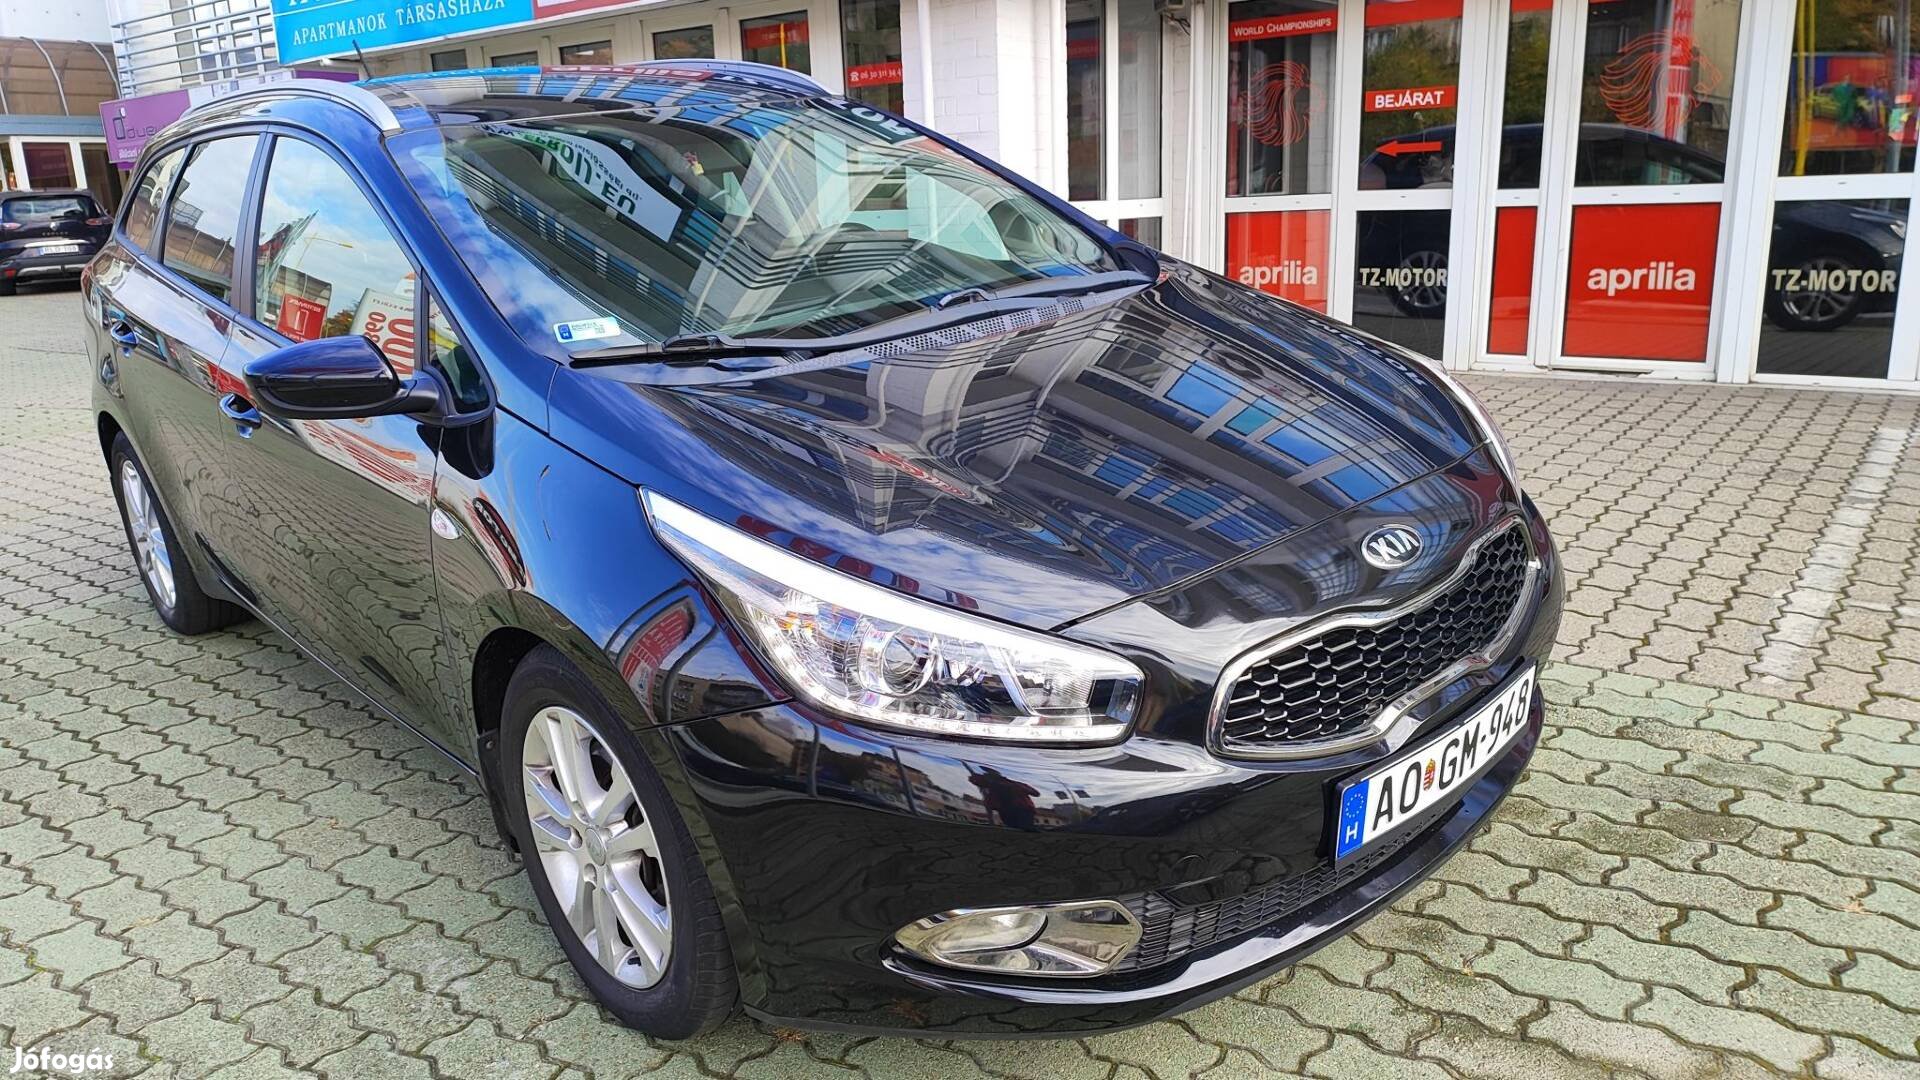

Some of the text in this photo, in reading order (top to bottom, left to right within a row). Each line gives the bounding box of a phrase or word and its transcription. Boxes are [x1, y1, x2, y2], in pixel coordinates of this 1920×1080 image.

[293, 12, 387, 45] APARTMANOK
[1234, 16, 1332, 37] WORLD CHAMPIONSHIPS
[1374, 90, 1444, 109] BEJÁRAT
[1239, 260, 1318, 289] aprilia
[1360, 267, 1447, 288] TZ-MOTOR
[1587, 261, 1696, 297] aprilia
[1772, 269, 1896, 293] TZ-MOTOR
[1371, 530, 1420, 561] KIA
[1345, 677, 1530, 844] H AO GM-948
